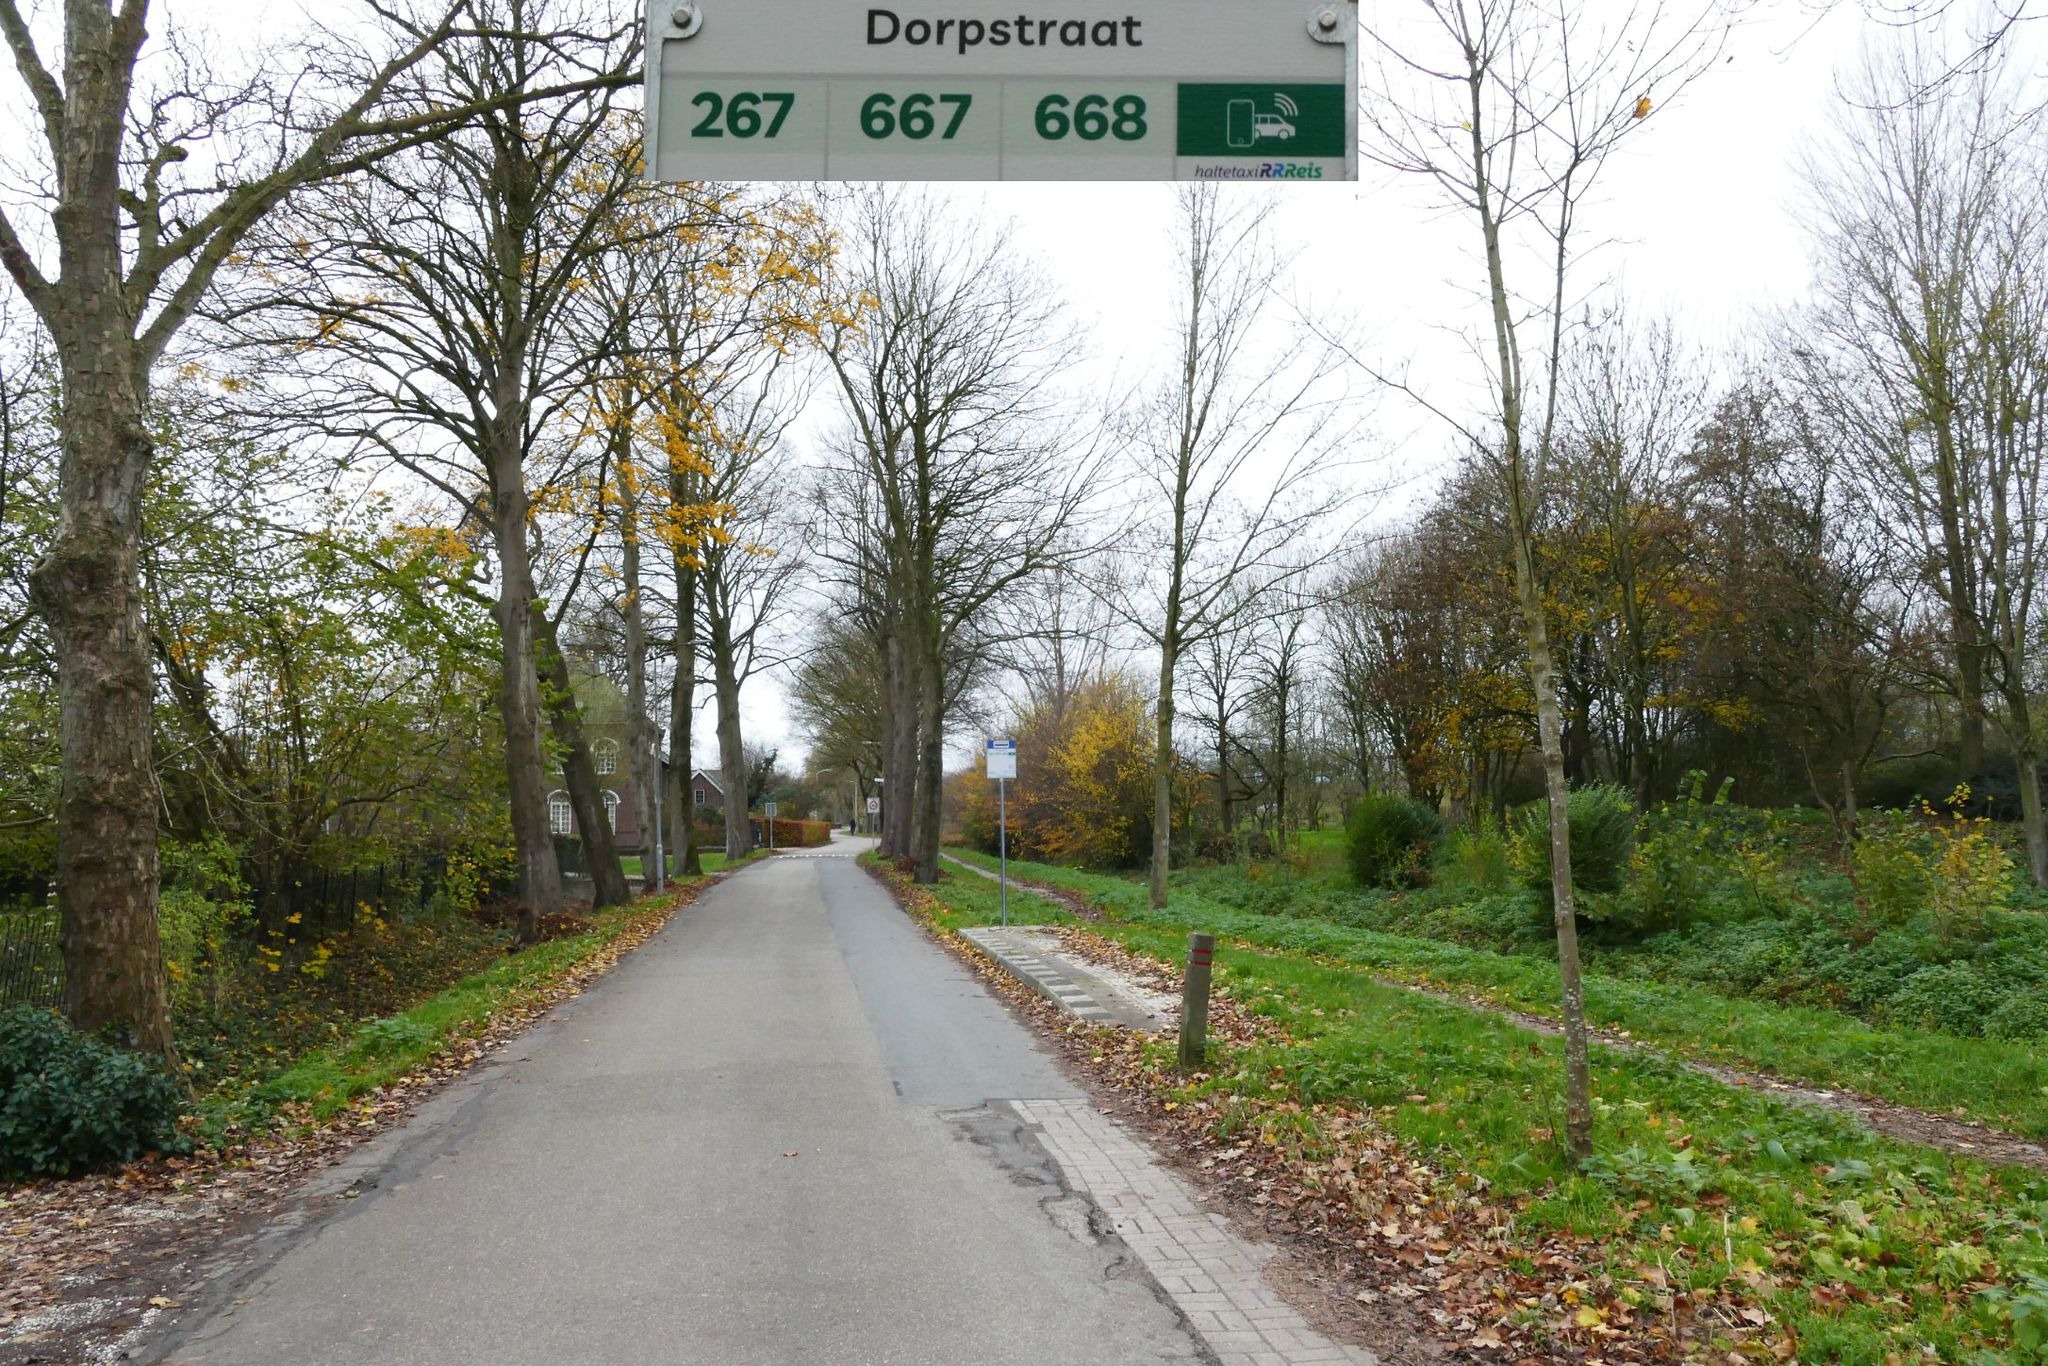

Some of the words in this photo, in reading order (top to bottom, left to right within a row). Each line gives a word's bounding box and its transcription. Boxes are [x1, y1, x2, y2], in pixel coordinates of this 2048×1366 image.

[866, 8, 1143, 55] Dorpstraat
[691, 91, 796, 139] 267
[859, 92, 973, 140] 667
[1034, 94, 1149, 141] 668
